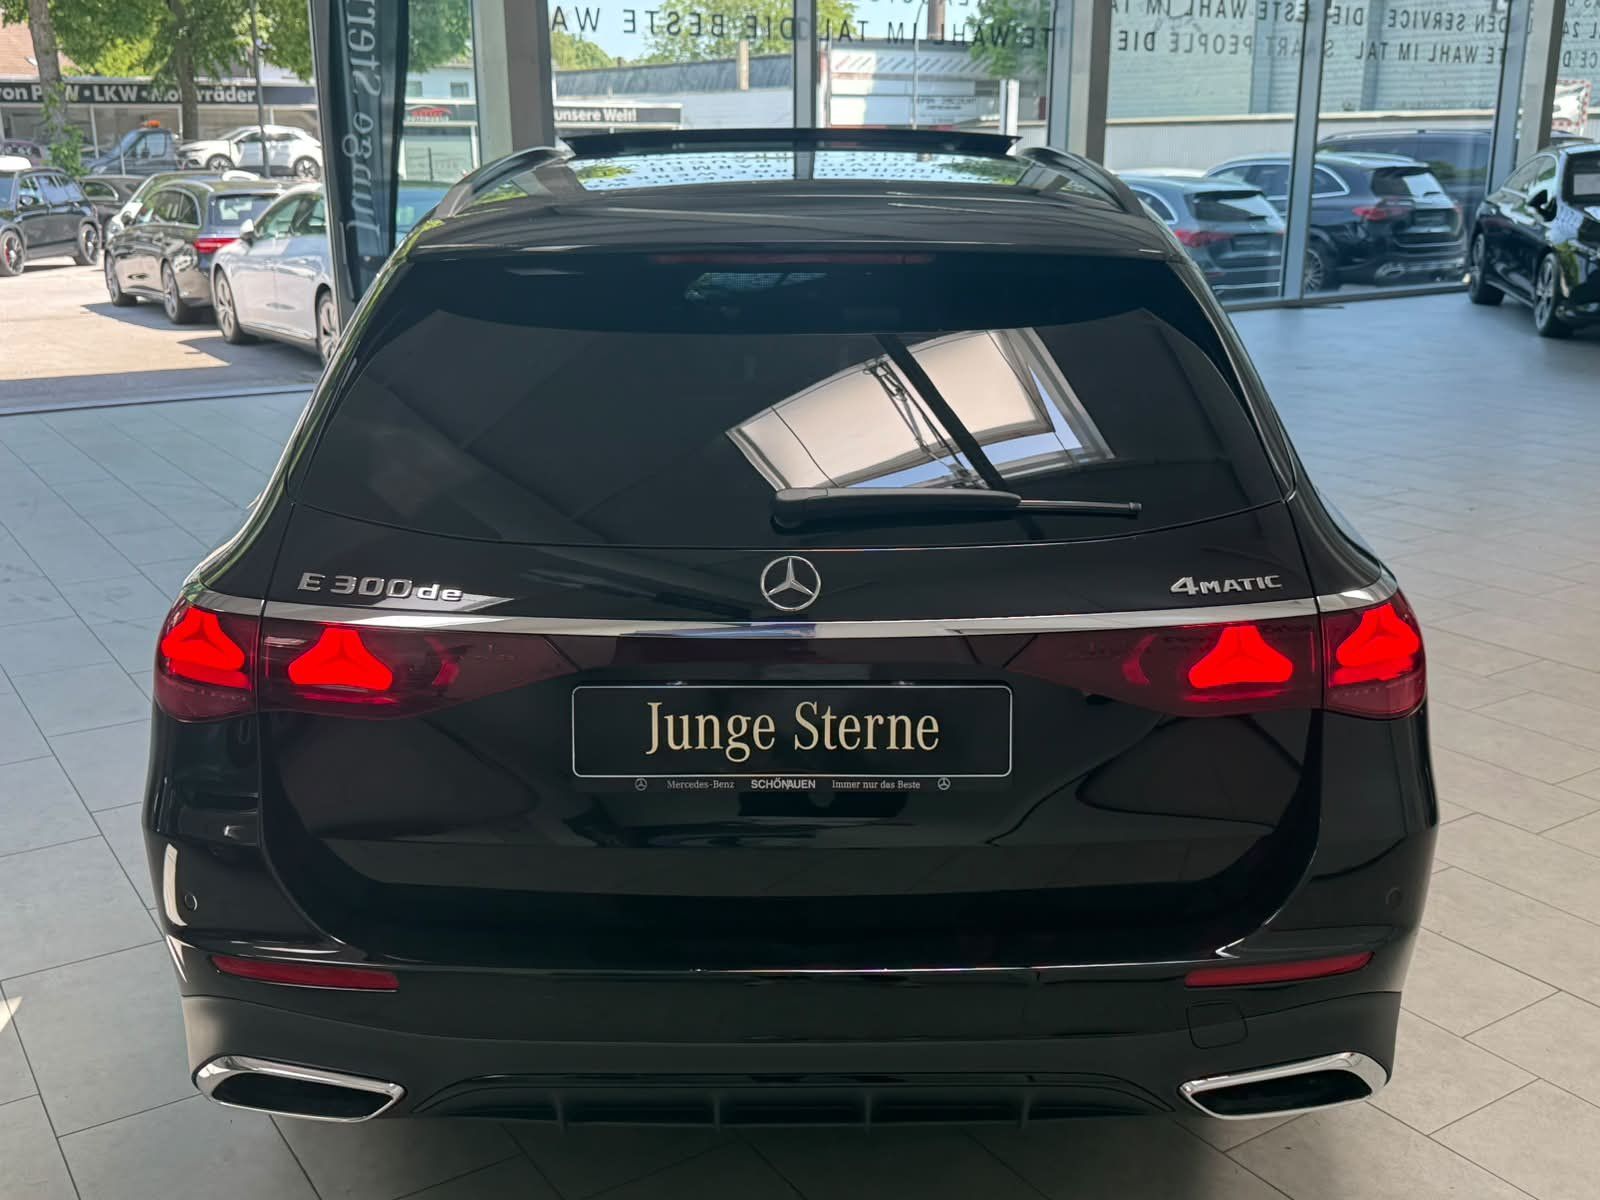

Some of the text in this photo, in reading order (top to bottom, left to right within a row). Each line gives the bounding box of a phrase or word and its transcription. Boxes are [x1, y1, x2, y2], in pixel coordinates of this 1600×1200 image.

[0, 86, 28, 100] on
[31, 84, 79, 102] PW
[93, 85, 139, 102] LKW
[297, 572, 326, 592] E
[1170, 575, 1283, 596] 4MATIC
[645, 701, 940, 763] Junge Sterne
[667, 779, 735, 790] Mercedes-Benz
[832, 779, 859, 790] Immer
[863, 781, 878, 789] nur
[881, 779, 895, 789] das
[897, 779, 921, 789] Beste
